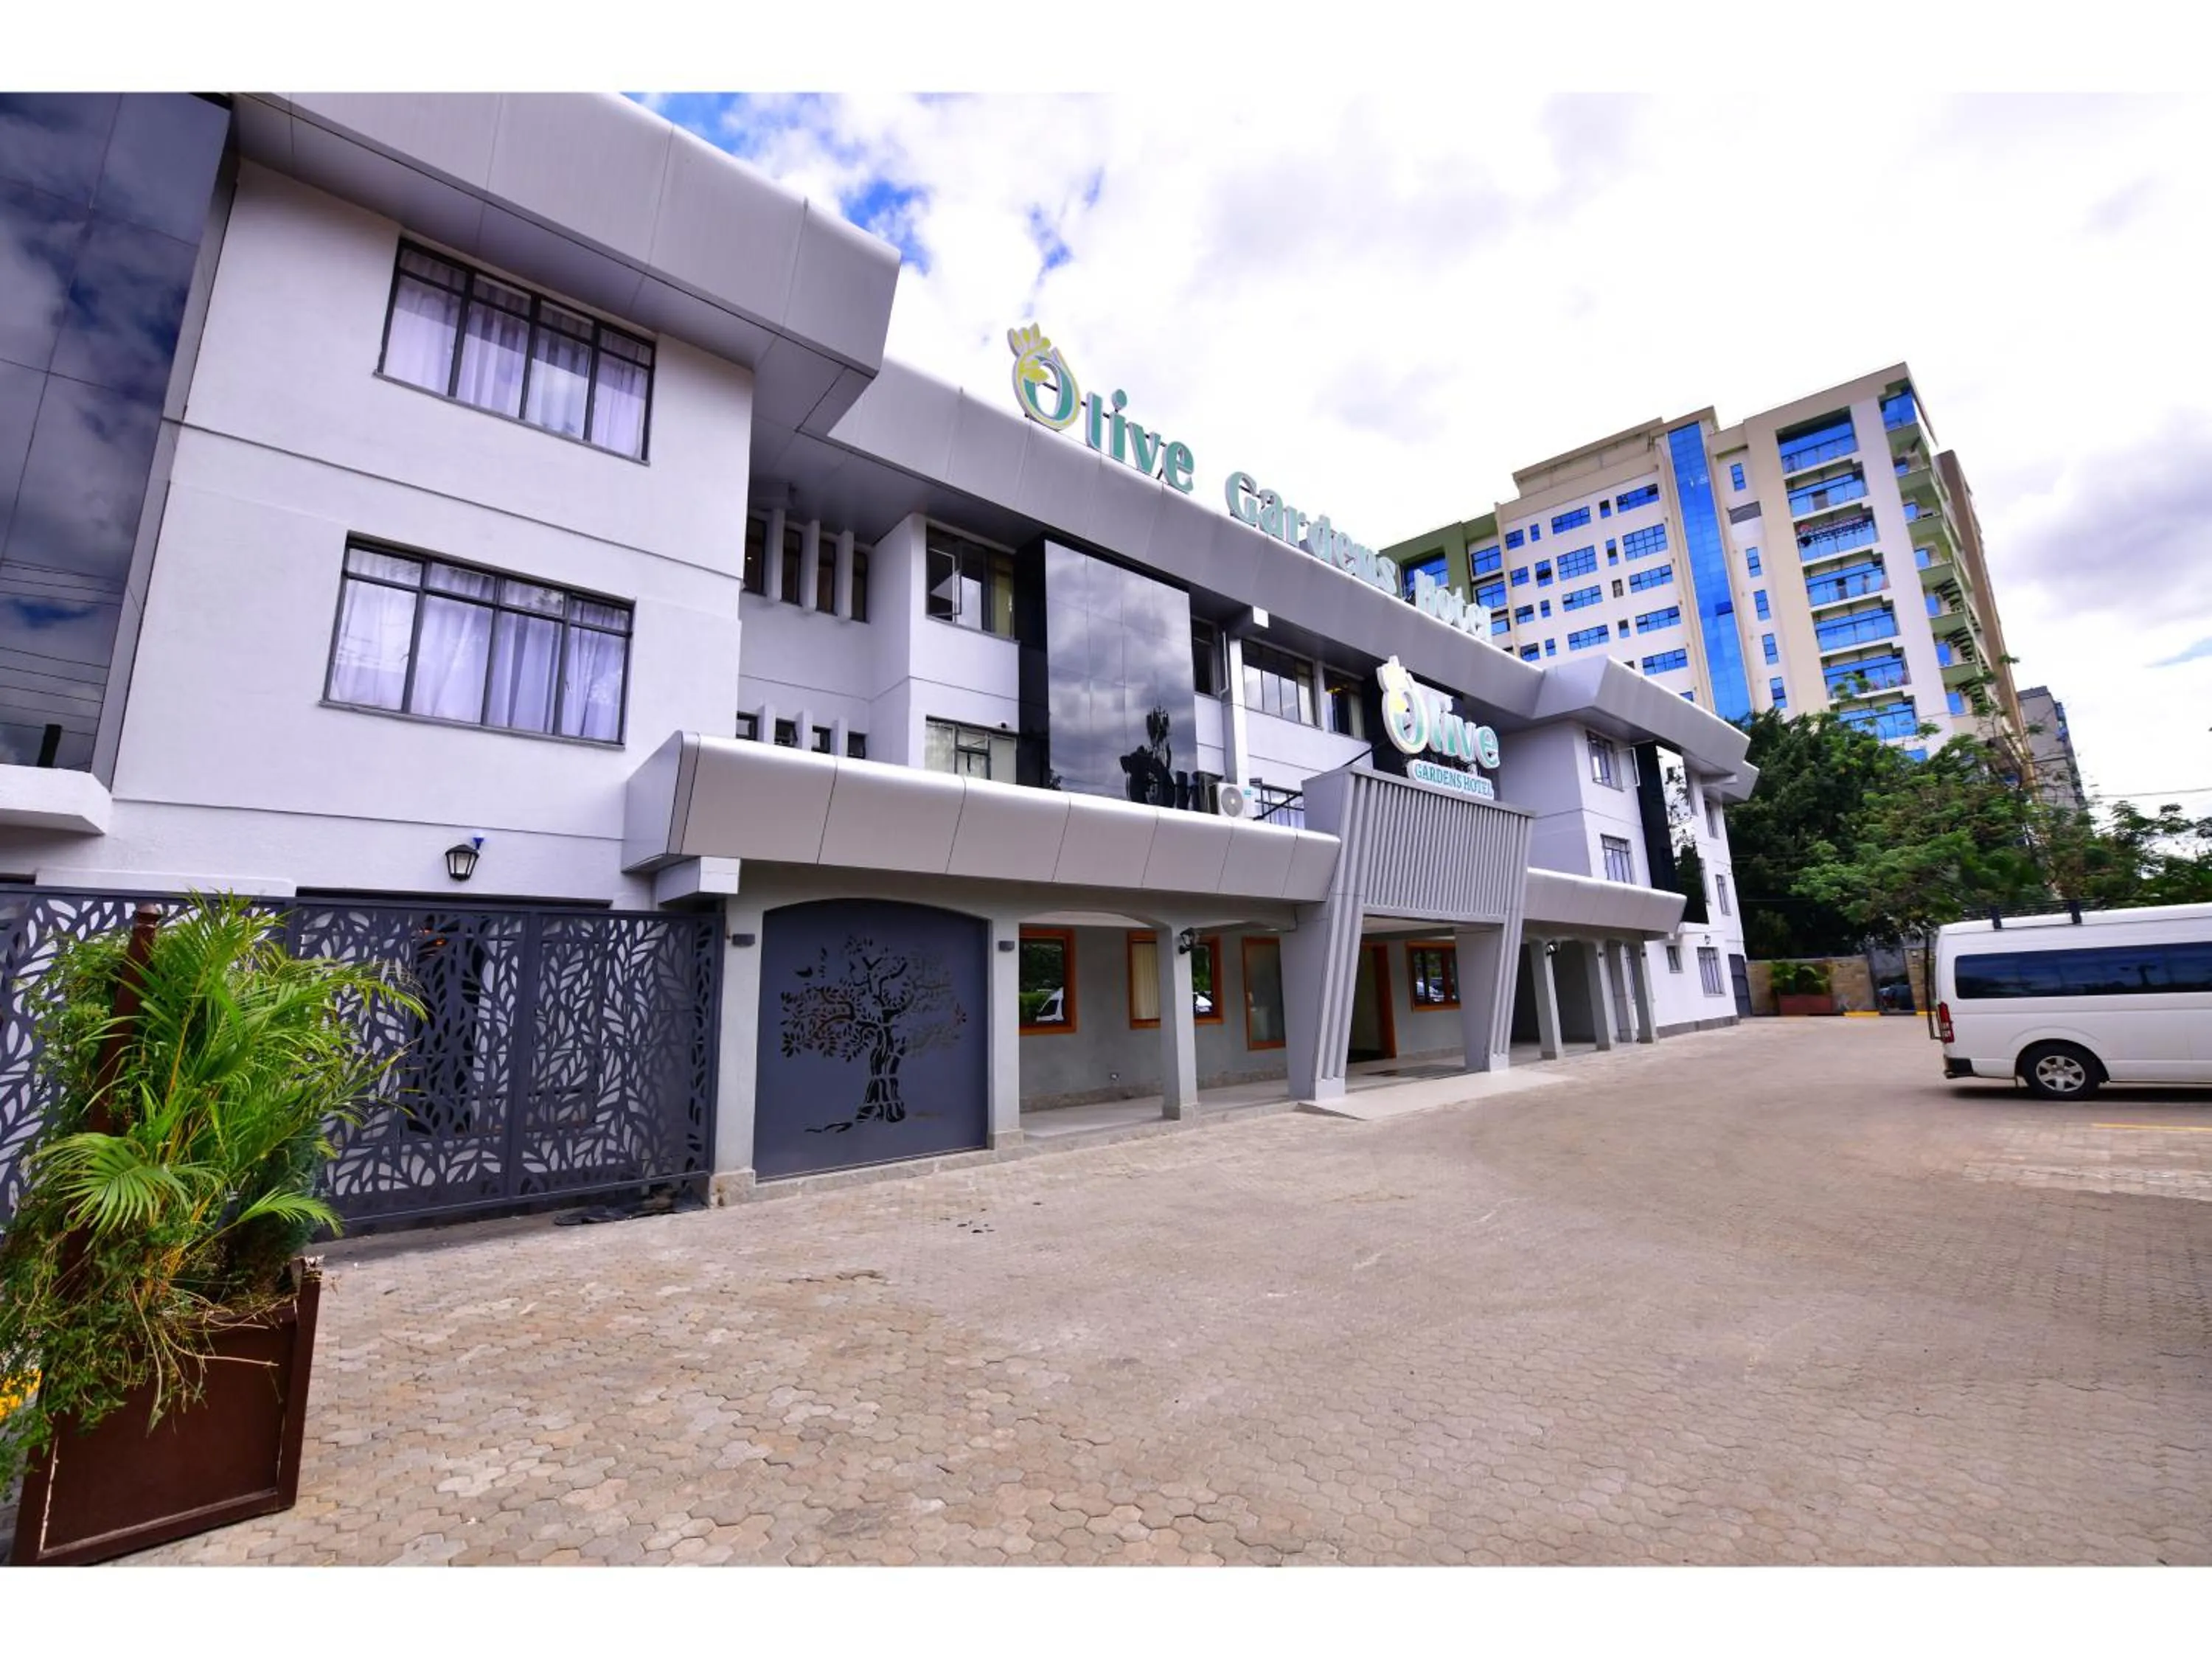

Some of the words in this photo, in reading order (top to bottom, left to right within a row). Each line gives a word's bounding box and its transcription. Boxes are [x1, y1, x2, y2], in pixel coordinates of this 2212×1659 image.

[1007, 322, 1194, 493] Olive
[1225, 471, 1397, 594] Gardens
[1377, 655, 1500, 768] Olive
[1415, 764, 1461, 788] GARDENS
[1463, 776, 1493, 796] HOTEL
